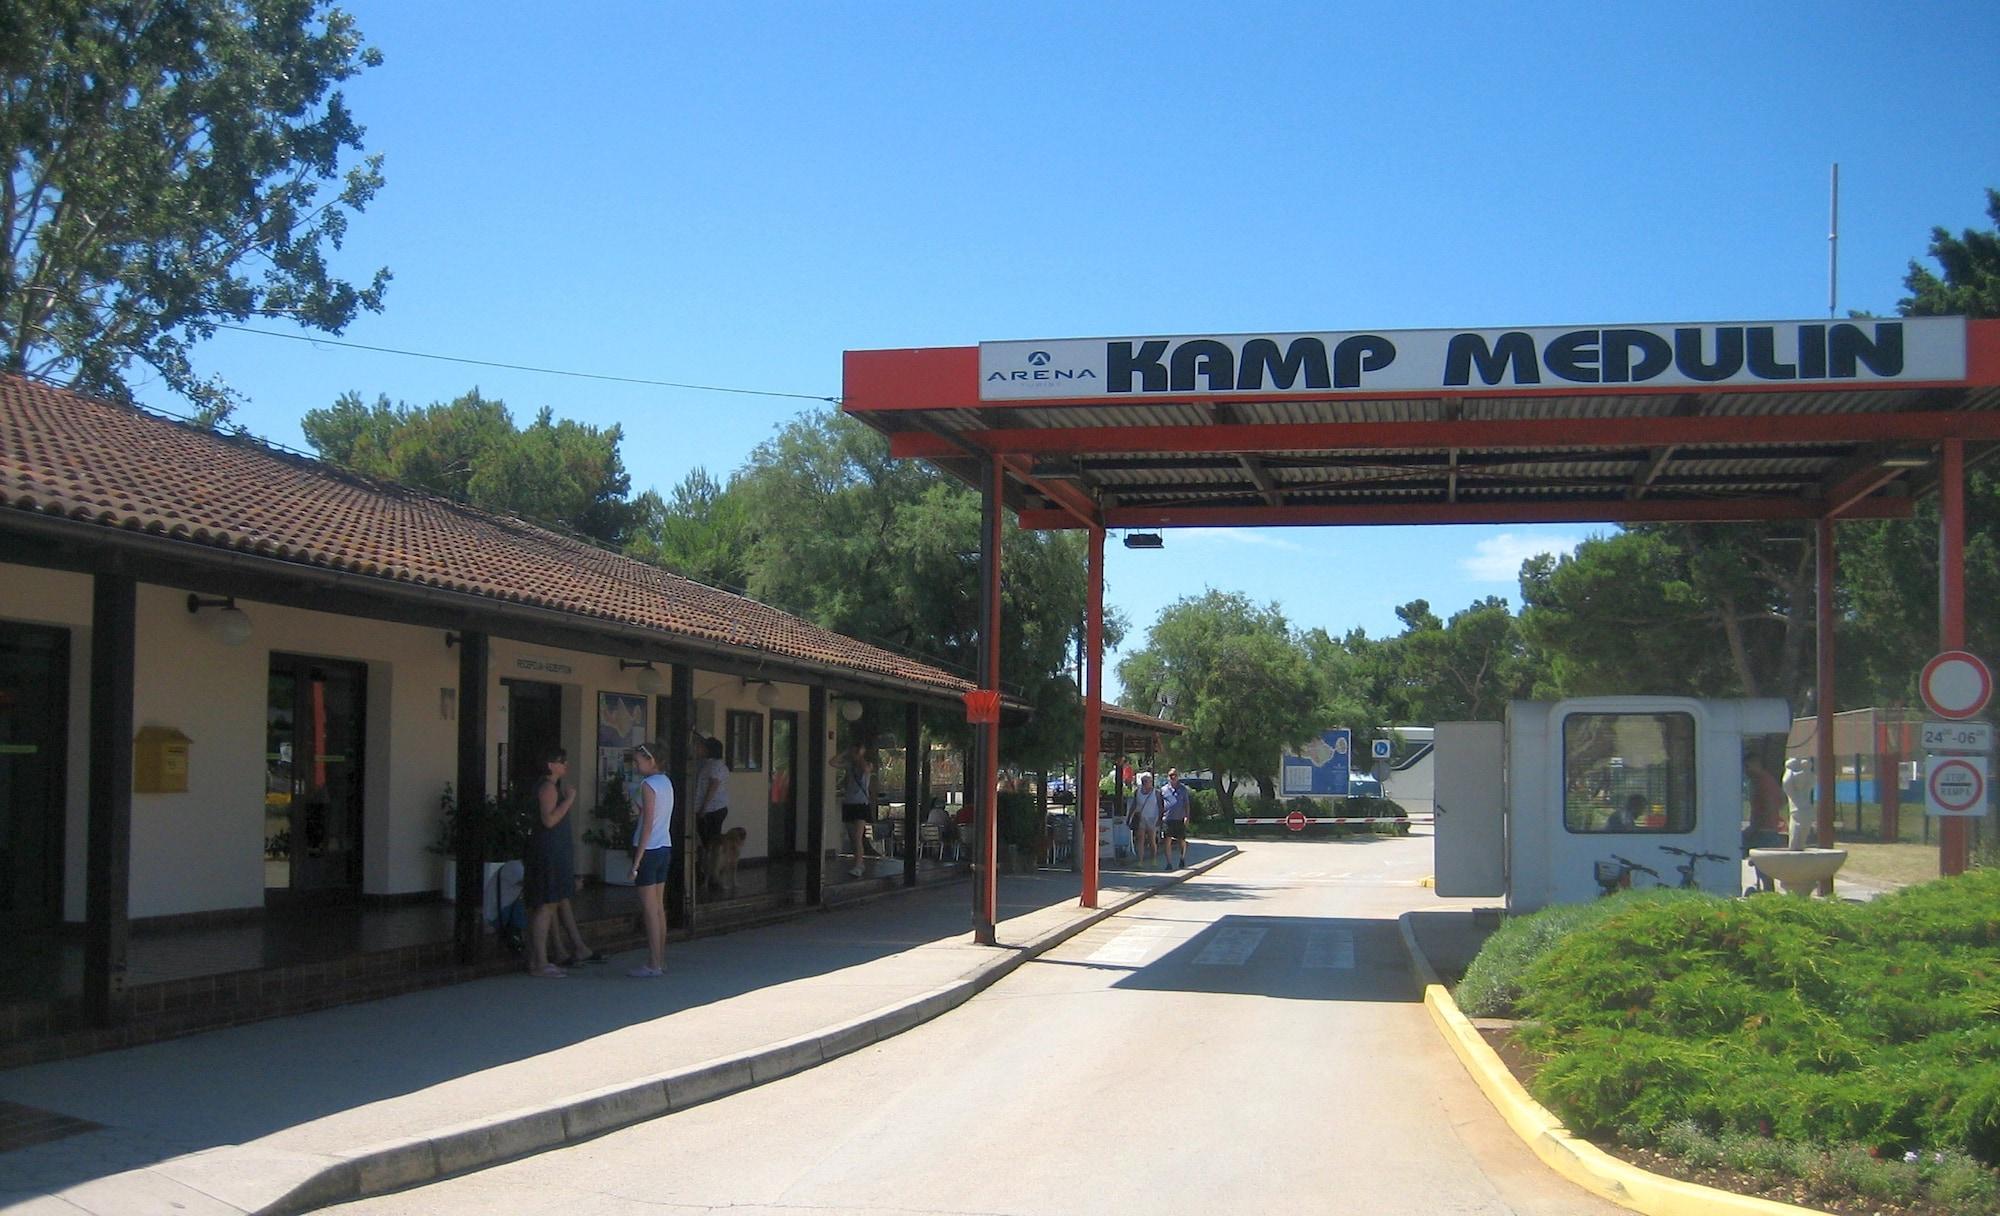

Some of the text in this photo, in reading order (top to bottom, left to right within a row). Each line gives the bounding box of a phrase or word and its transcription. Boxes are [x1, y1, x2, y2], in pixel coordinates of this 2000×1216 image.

[986, 368, 1097, 382] ARENA
[1106, 322, 1905, 393] KAMP MEDULIN
